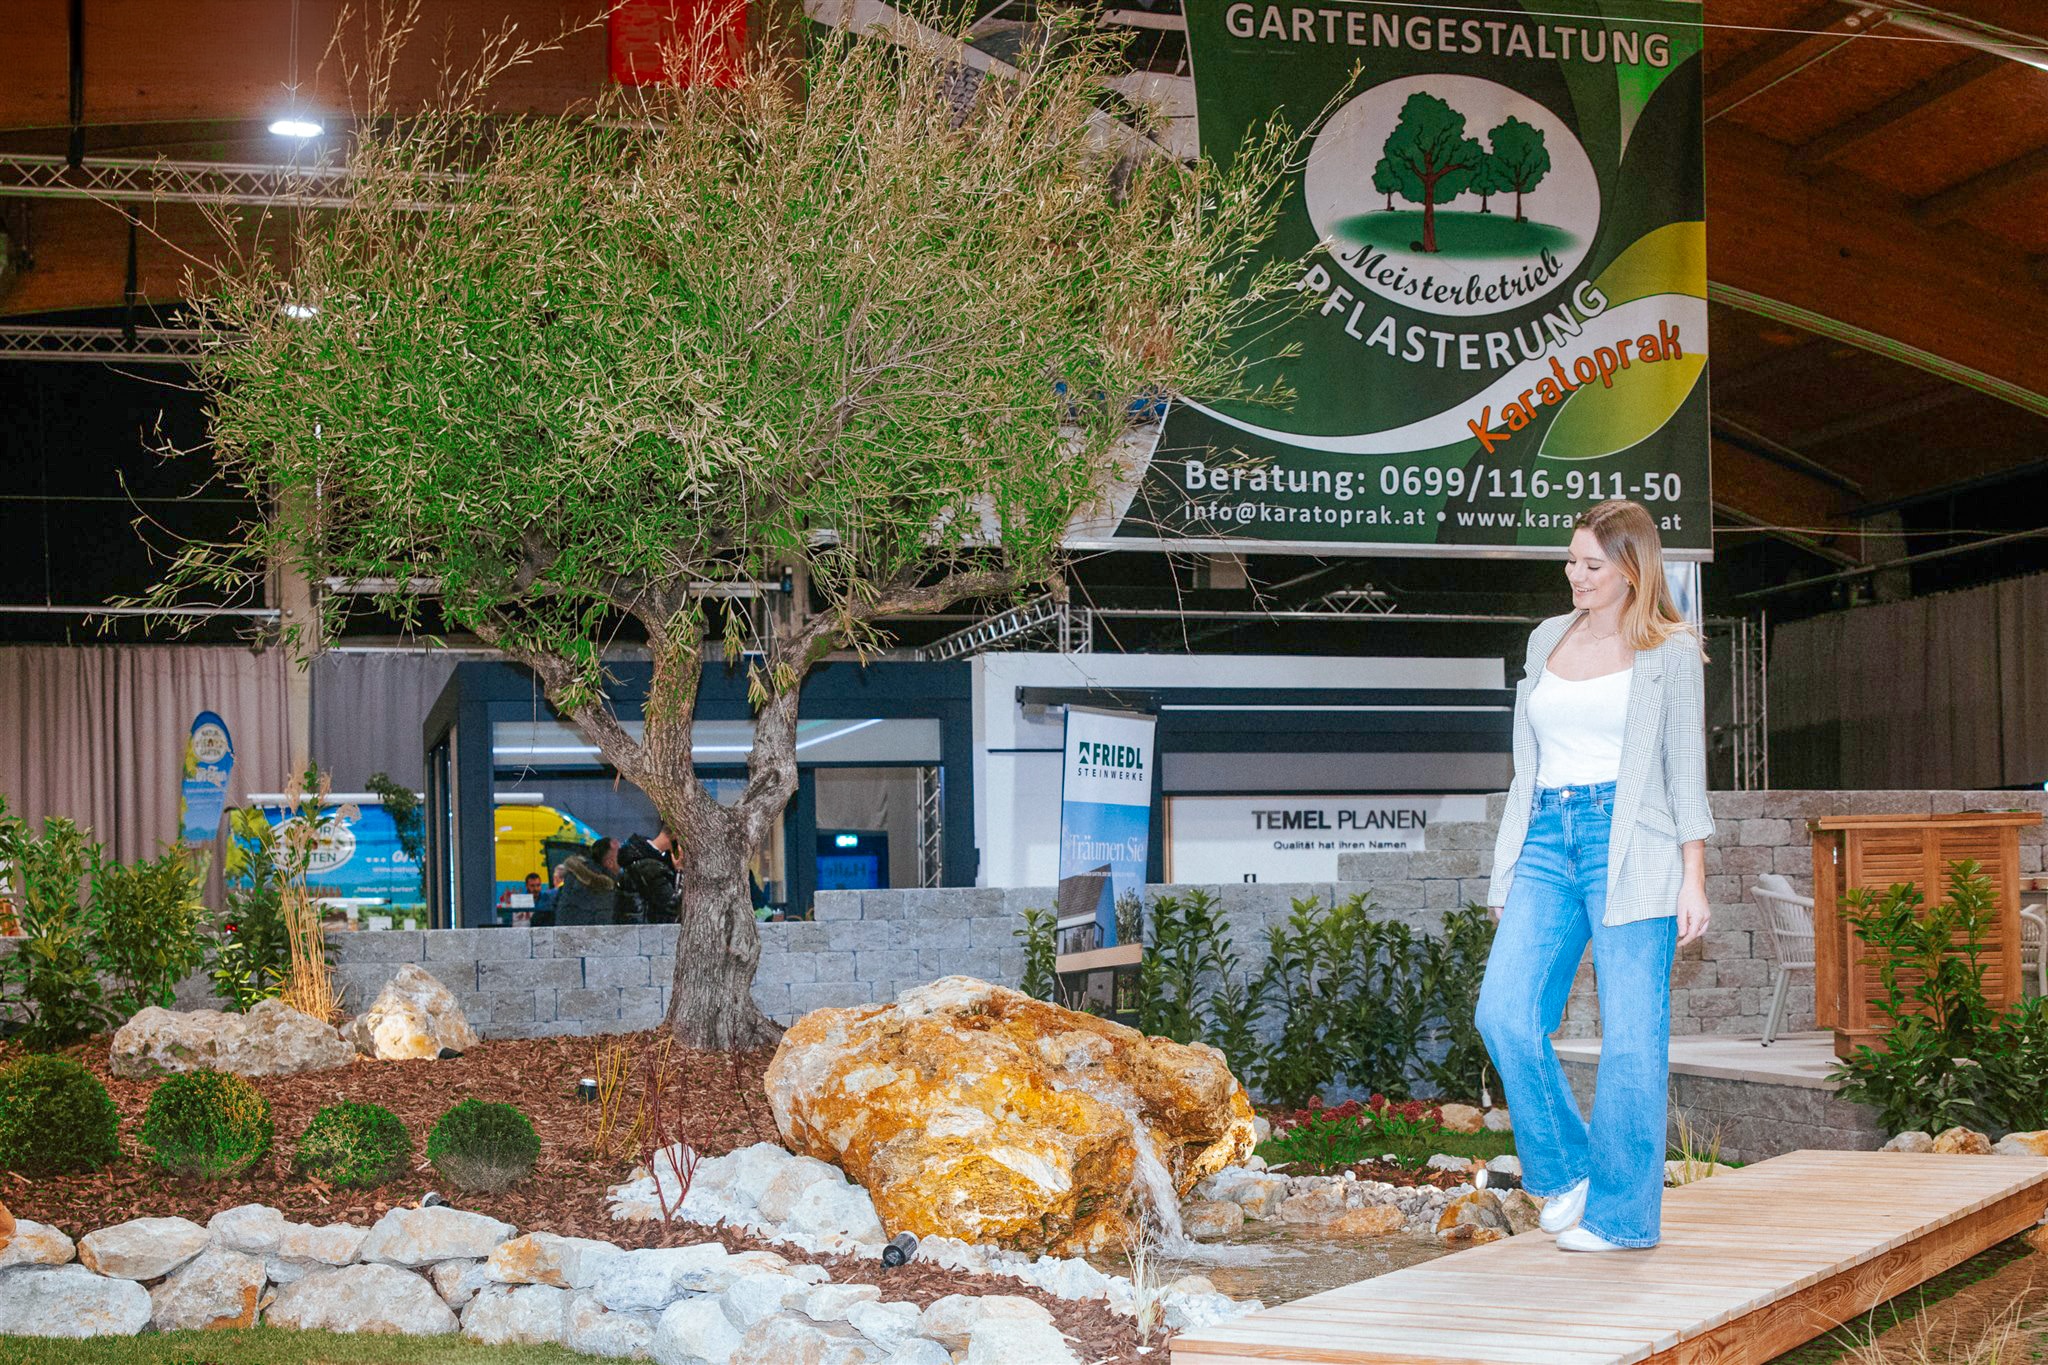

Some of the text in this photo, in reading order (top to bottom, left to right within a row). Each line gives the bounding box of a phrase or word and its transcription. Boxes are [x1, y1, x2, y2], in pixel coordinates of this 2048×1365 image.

[1224, 2, 1671, 69] GARTENGESTALTUNG
[1340, 243, 1564, 305] Meisterbetrieb
[1295, 262, 1610, 371] PFLASTERUNG
[1467, 319, 1683, 455] Karatoprak
[1184, 459, 1683, 503] Beratung: 0699/116-911-50
[1184, 500, 1427, 528] info@karatoprak.at
[1092, 742, 1143, 770] FRIEDL
[1077, 767, 1144, 782] STEINWERKE
[1251, 810, 1427, 830] TEMEL PLANEN
[1070, 833, 1145, 862] Träumen Sie
[1273, 840, 1316, 851] Qualität
[1318, 841, 1335, 850] hat
[1369, 841, 1408, 850] Namen
